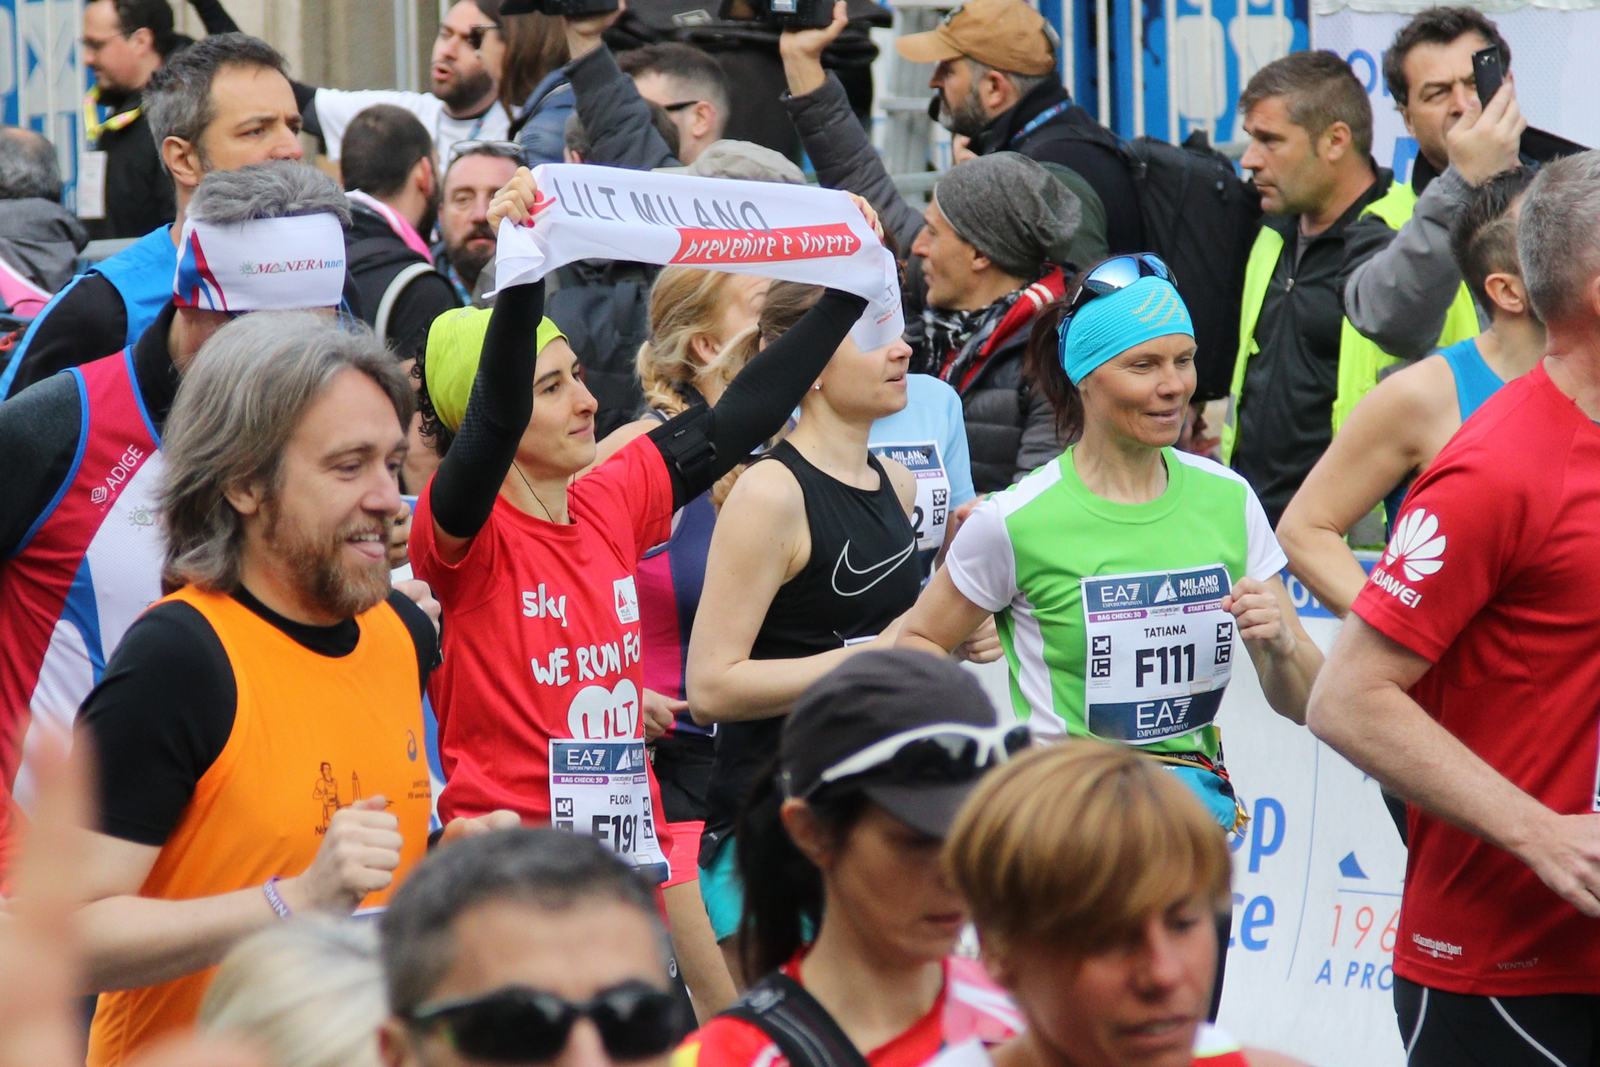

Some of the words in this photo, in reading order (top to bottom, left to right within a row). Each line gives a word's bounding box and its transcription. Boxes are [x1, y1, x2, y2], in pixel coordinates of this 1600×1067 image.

[553, 178, 625, 222] LILT
[630, 191, 772, 233] MILANO
[679, 232, 777, 262] prevenire
[799, 232, 854, 254] vivere
[106, 444, 143, 491] ADIGE
[912, 505, 924, 539] 2
[1101, 583, 1141, 602] EA7
[1180, 575, 1219, 591] MILANO
[1180, 586, 1219, 597] MARATHON
[522, 583, 567, 628] sky
[1187, 604, 1204, 612] START
[1205, 601, 1221, 609] SECTO
[1144, 625, 1187, 638] TATIANA
[531, 647, 571, 687] WE
[576, 641, 621, 682] RUN
[623, 631, 640, 668] FO
[1135, 643, 1195, 688] F111
[582, 700, 634, 739] LILT
[1136, 698, 1192, 729] EA7
[567, 749, 606, 766] EA7
[560, 776, 574, 784] BAG
[610, 795, 631, 805] FLORA
[1332, 905, 1400, 952] 196
[1314, 959, 1331, 985] A
[1344, 961, 1394, 991] PRO
